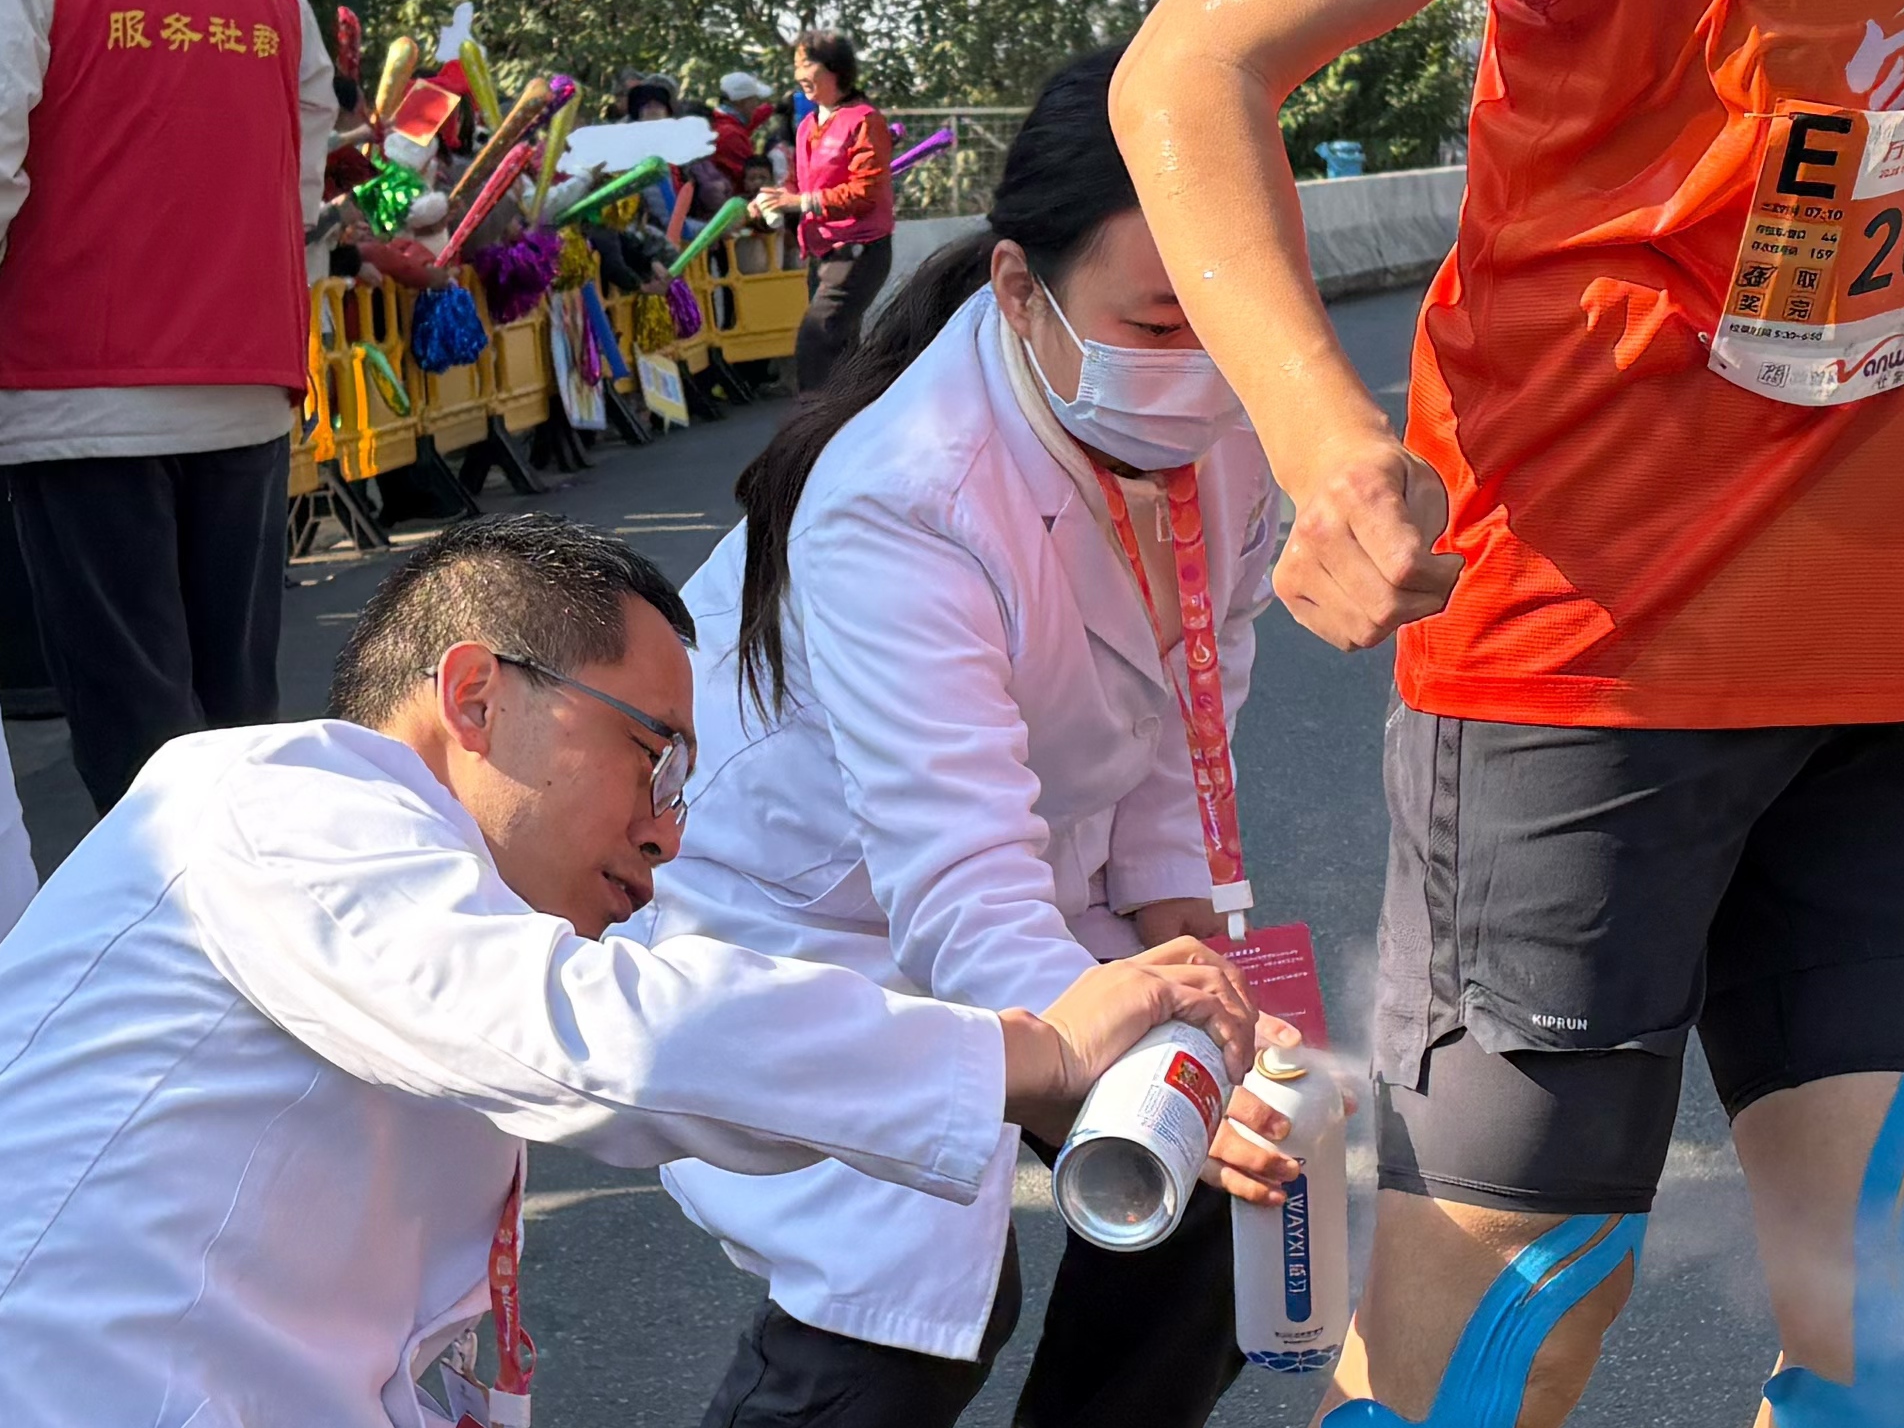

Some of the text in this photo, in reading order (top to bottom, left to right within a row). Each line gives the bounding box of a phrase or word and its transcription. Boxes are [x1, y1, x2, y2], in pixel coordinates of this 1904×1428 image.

[107, 10, 280, 58] 服务社群
[1776, 112, 1852, 200] E
[1531, 1014, 1588, 1031] KIPRUN
[1286, 1193, 1305, 1257] WAYXI
